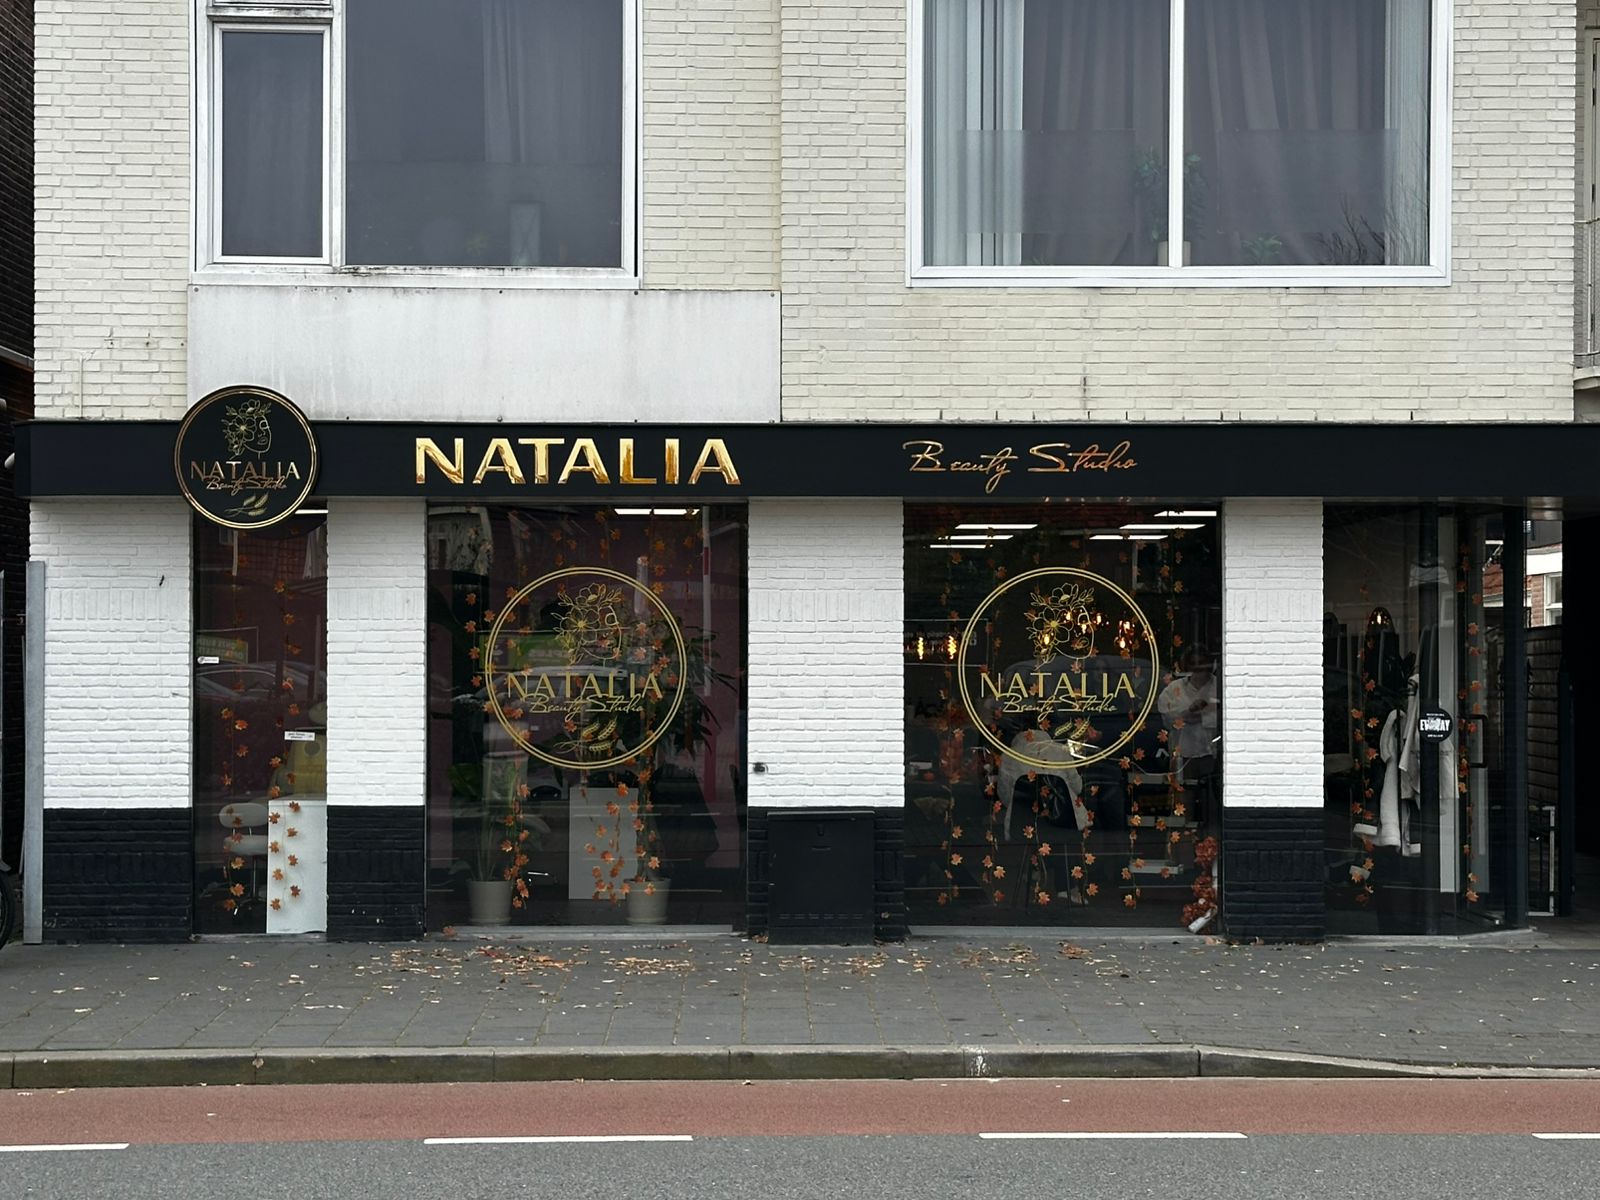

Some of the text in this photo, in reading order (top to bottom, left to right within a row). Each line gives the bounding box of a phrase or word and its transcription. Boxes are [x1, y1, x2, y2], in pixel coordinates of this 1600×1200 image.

[191, 461, 300, 481] NATALIA
[416, 438, 741, 484] NATALIA
[902, 440, 1138, 493] Beauty Studio
[508, 672, 663, 700] NATALIA
[981, 672, 1136, 700] NATALIA
